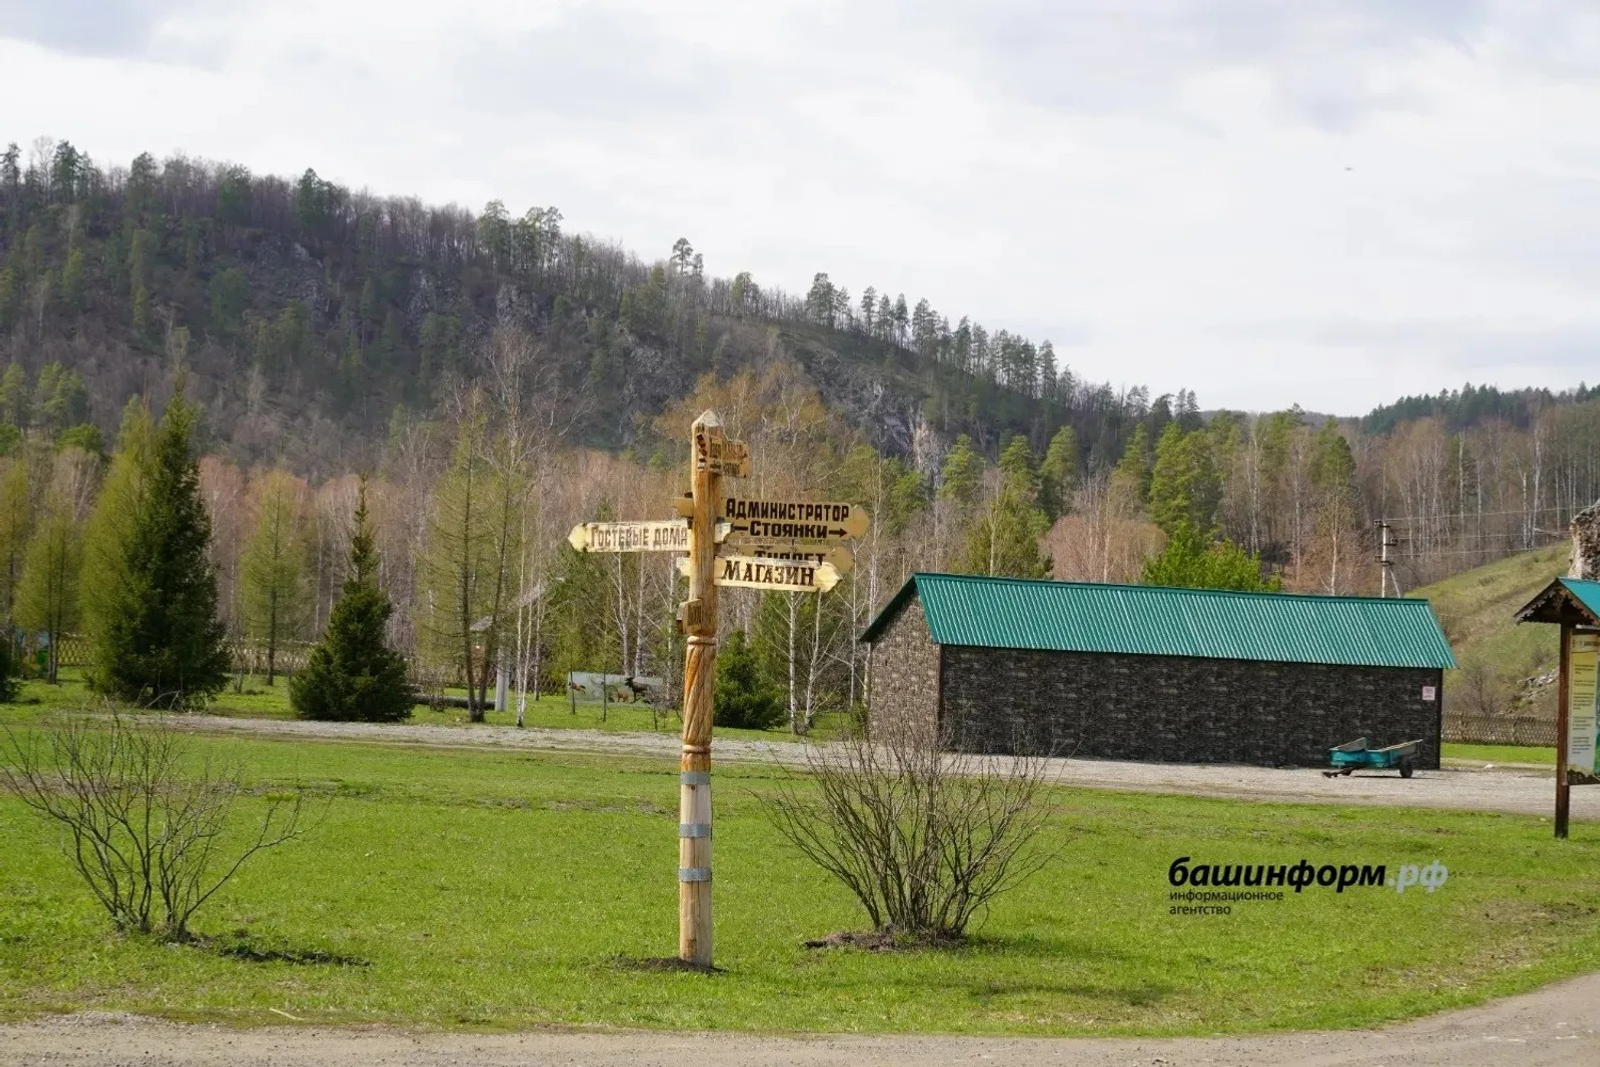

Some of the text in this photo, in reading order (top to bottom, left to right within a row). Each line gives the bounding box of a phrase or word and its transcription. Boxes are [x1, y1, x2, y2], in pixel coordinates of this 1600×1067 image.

[726, 498, 849, 522] АДМИНИСТРАТОР
[591, 525, 688, 547] ГОСТЕВЫЕ ДОМА
[749, 521, 827, 538] СТОЯНКИ
[721, 560, 815, 587] МАГАЗИН
